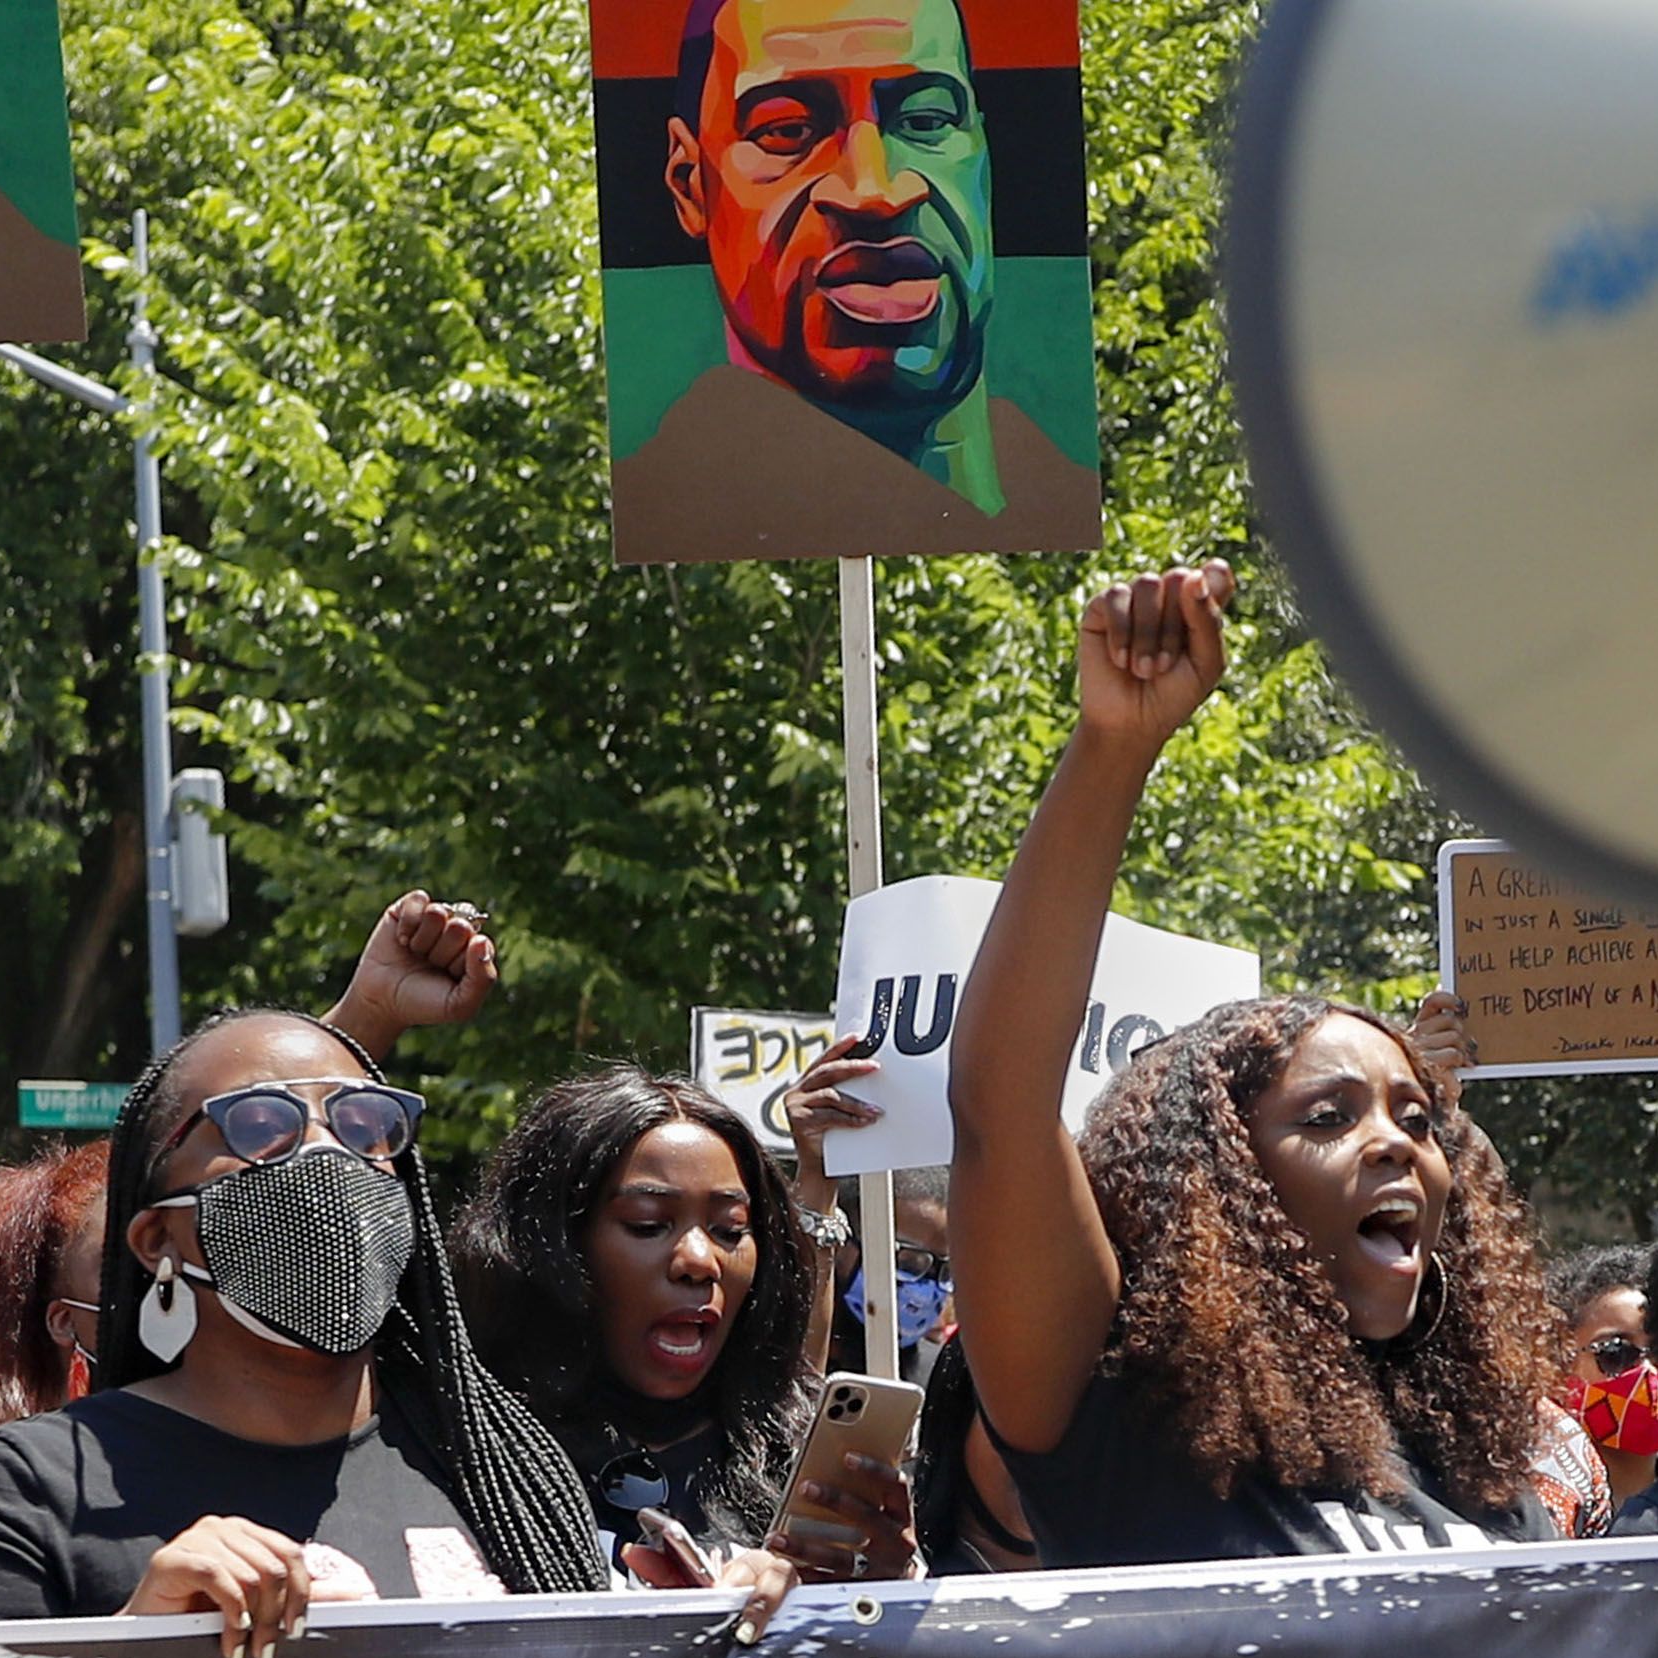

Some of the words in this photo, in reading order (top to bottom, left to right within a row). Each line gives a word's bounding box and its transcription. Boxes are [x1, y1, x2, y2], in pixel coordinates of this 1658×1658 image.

[1469, 867, 1486, 897] A
[1465, 918, 1484, 933] IN
[1493, 914, 1538, 931] JUST
[1548, 909, 1561, 930] A
[1457, 950, 1496, 975] WILL
[1509, 947, 1554, 970] HELP
[1567, 941, 1635, 966] ACHIEVE
[1646, 937, 1658, 960] A
[1479, 995, 1513, 1016] THE
[1523, 981, 1595, 1014] DESTINY
[1632, 984, 1644, 1004] A
